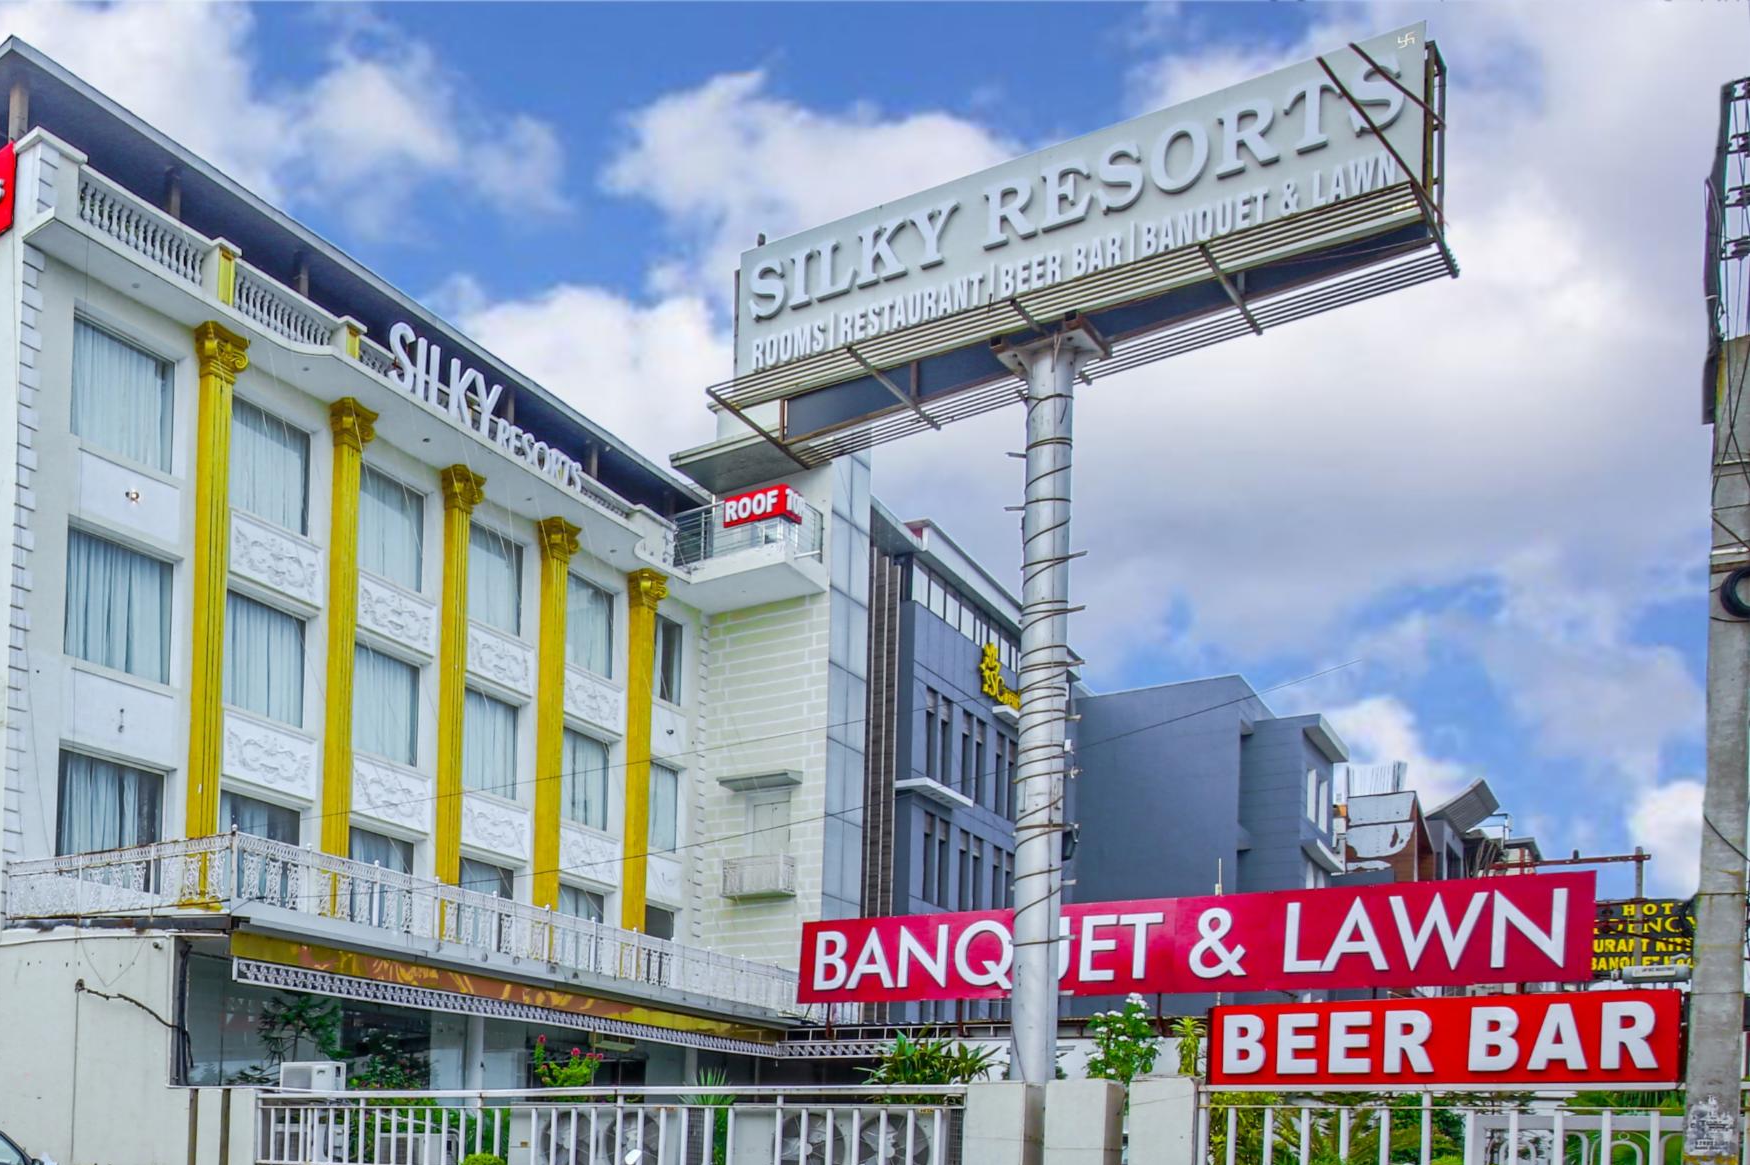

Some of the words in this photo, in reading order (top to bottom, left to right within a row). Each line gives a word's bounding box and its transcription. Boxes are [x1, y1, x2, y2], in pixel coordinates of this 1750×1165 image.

[749, 200, 960, 322] SILKY
[982, 54, 1407, 251] RESORTS
[753, 319, 826, 373] ROOMS
[841, 271, 985, 344] RESTAURANT
[1001, 249, 1063, 298] BEER
[1072, 230, 1123, 277] BAR
[1144, 189, 1271, 255] BANQUET
[1278, 181, 1300, 216] &
[1312, 151, 1397, 205] LAWN
[388, 322, 504, 438] SILKY
[497, 417, 583, 494] RESORTS
[724, 489, 779, 523] ROOF
[1188, 907, 1247, 979] &
[1282, 887, 1569, 973] LAWN
[1221, 1009, 1435, 1075] BEER
[1467, 1000, 1659, 1072] BAR
